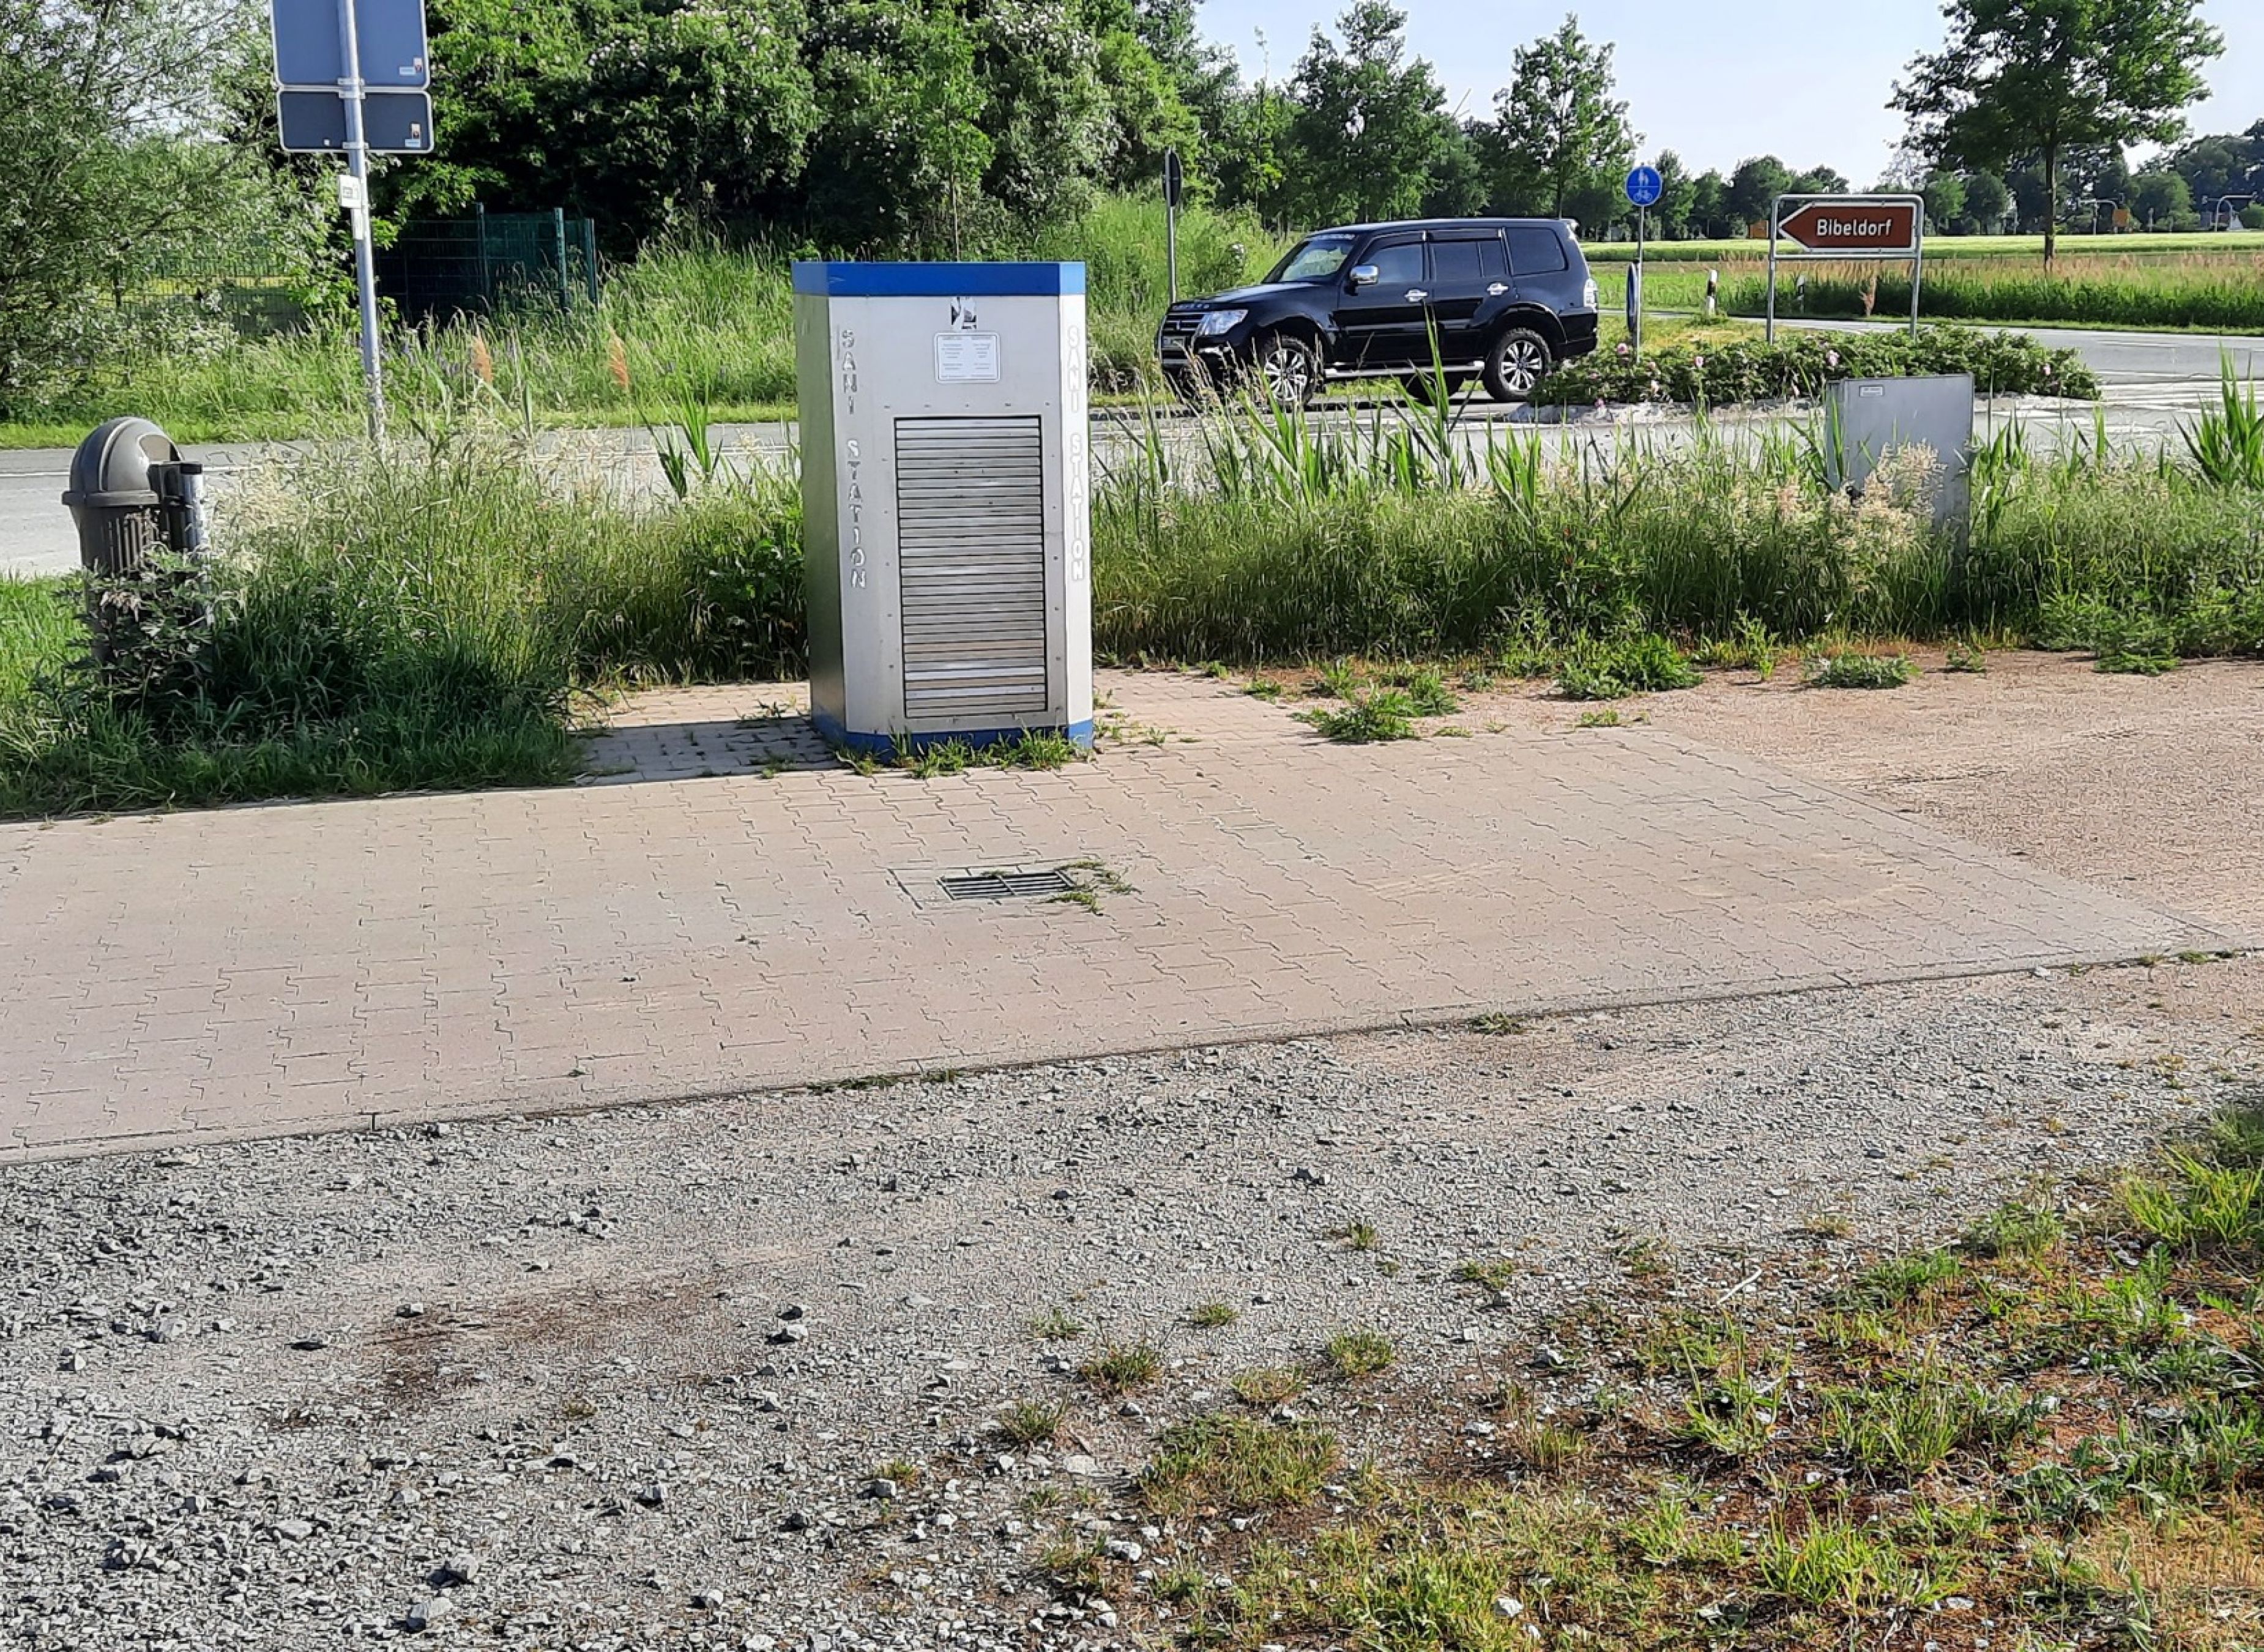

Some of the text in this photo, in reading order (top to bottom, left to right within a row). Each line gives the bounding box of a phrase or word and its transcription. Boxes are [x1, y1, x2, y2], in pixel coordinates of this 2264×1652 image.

[1816, 218, 1892, 236] Bibeldorf
[841, 330, 866, 588] SANI STATION
[1068, 327, 1084, 580] SANI STATION
